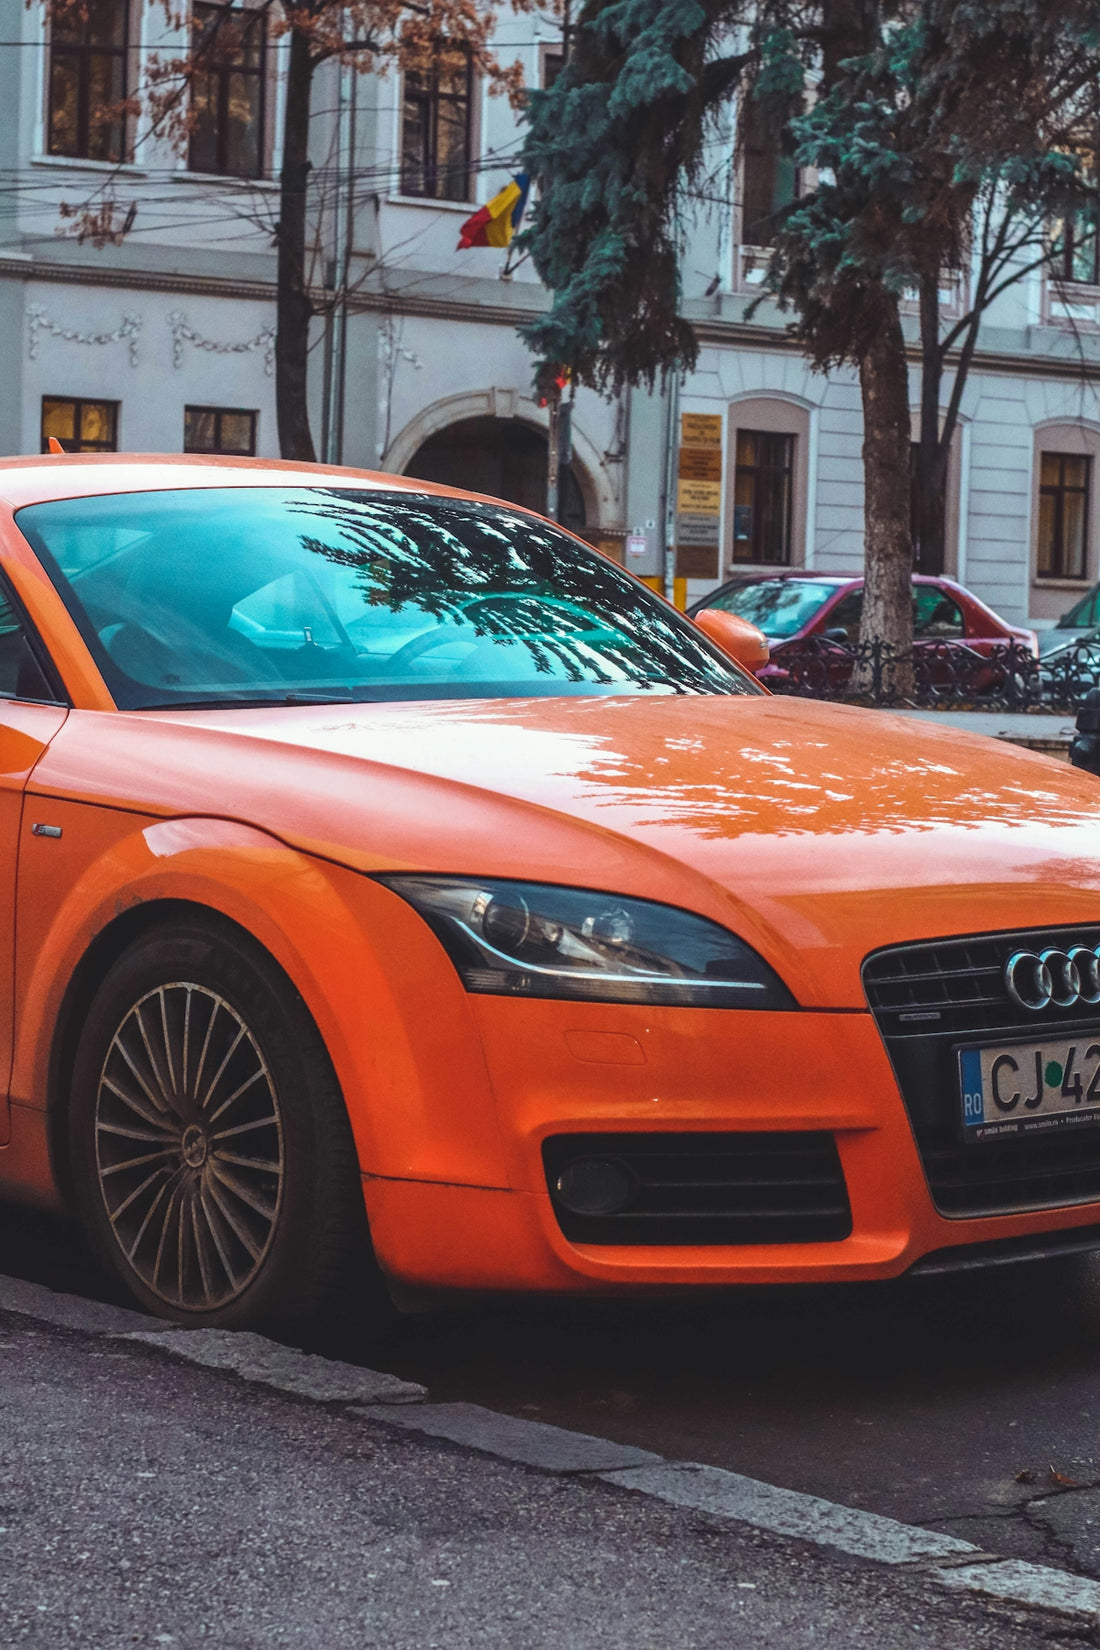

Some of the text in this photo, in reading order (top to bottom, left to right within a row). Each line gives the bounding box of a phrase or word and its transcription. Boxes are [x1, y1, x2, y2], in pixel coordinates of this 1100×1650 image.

[992, 1044, 1100, 1111] CJ 42
[964, 1093, 981, 1116] RO
